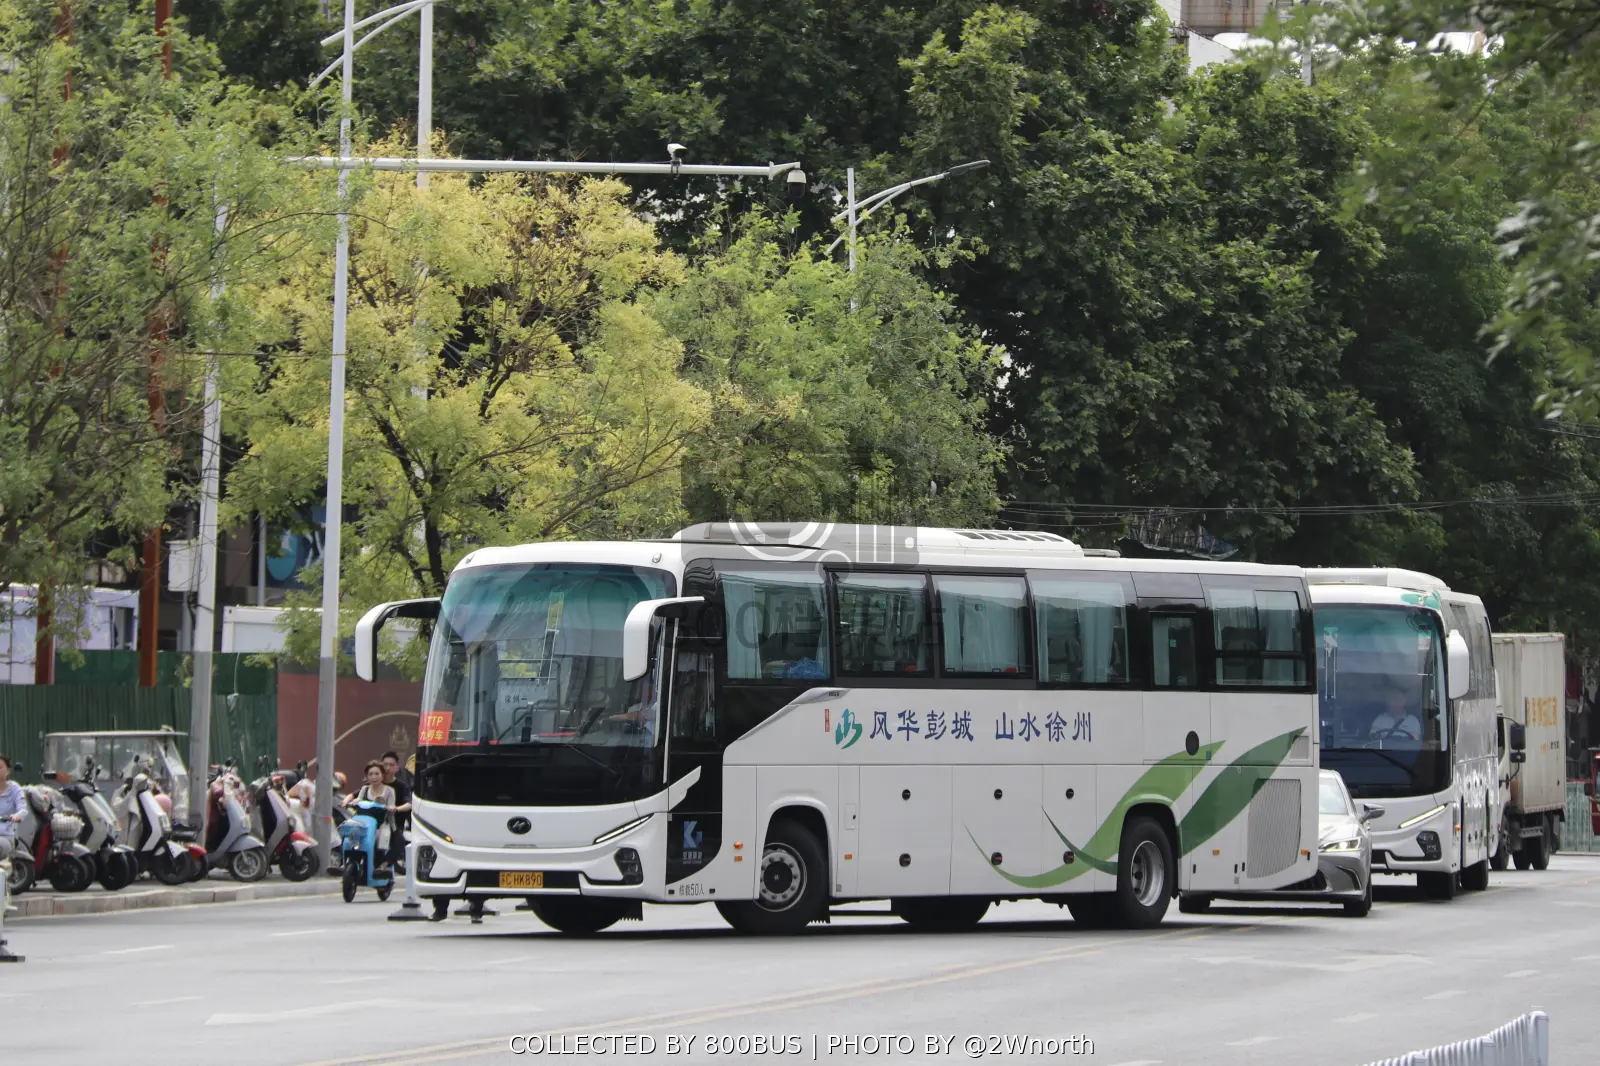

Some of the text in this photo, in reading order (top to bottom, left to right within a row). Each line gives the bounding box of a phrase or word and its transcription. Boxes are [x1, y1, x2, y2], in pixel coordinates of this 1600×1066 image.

[870, 709, 1092, 742] 风华彭城 山水徐州
